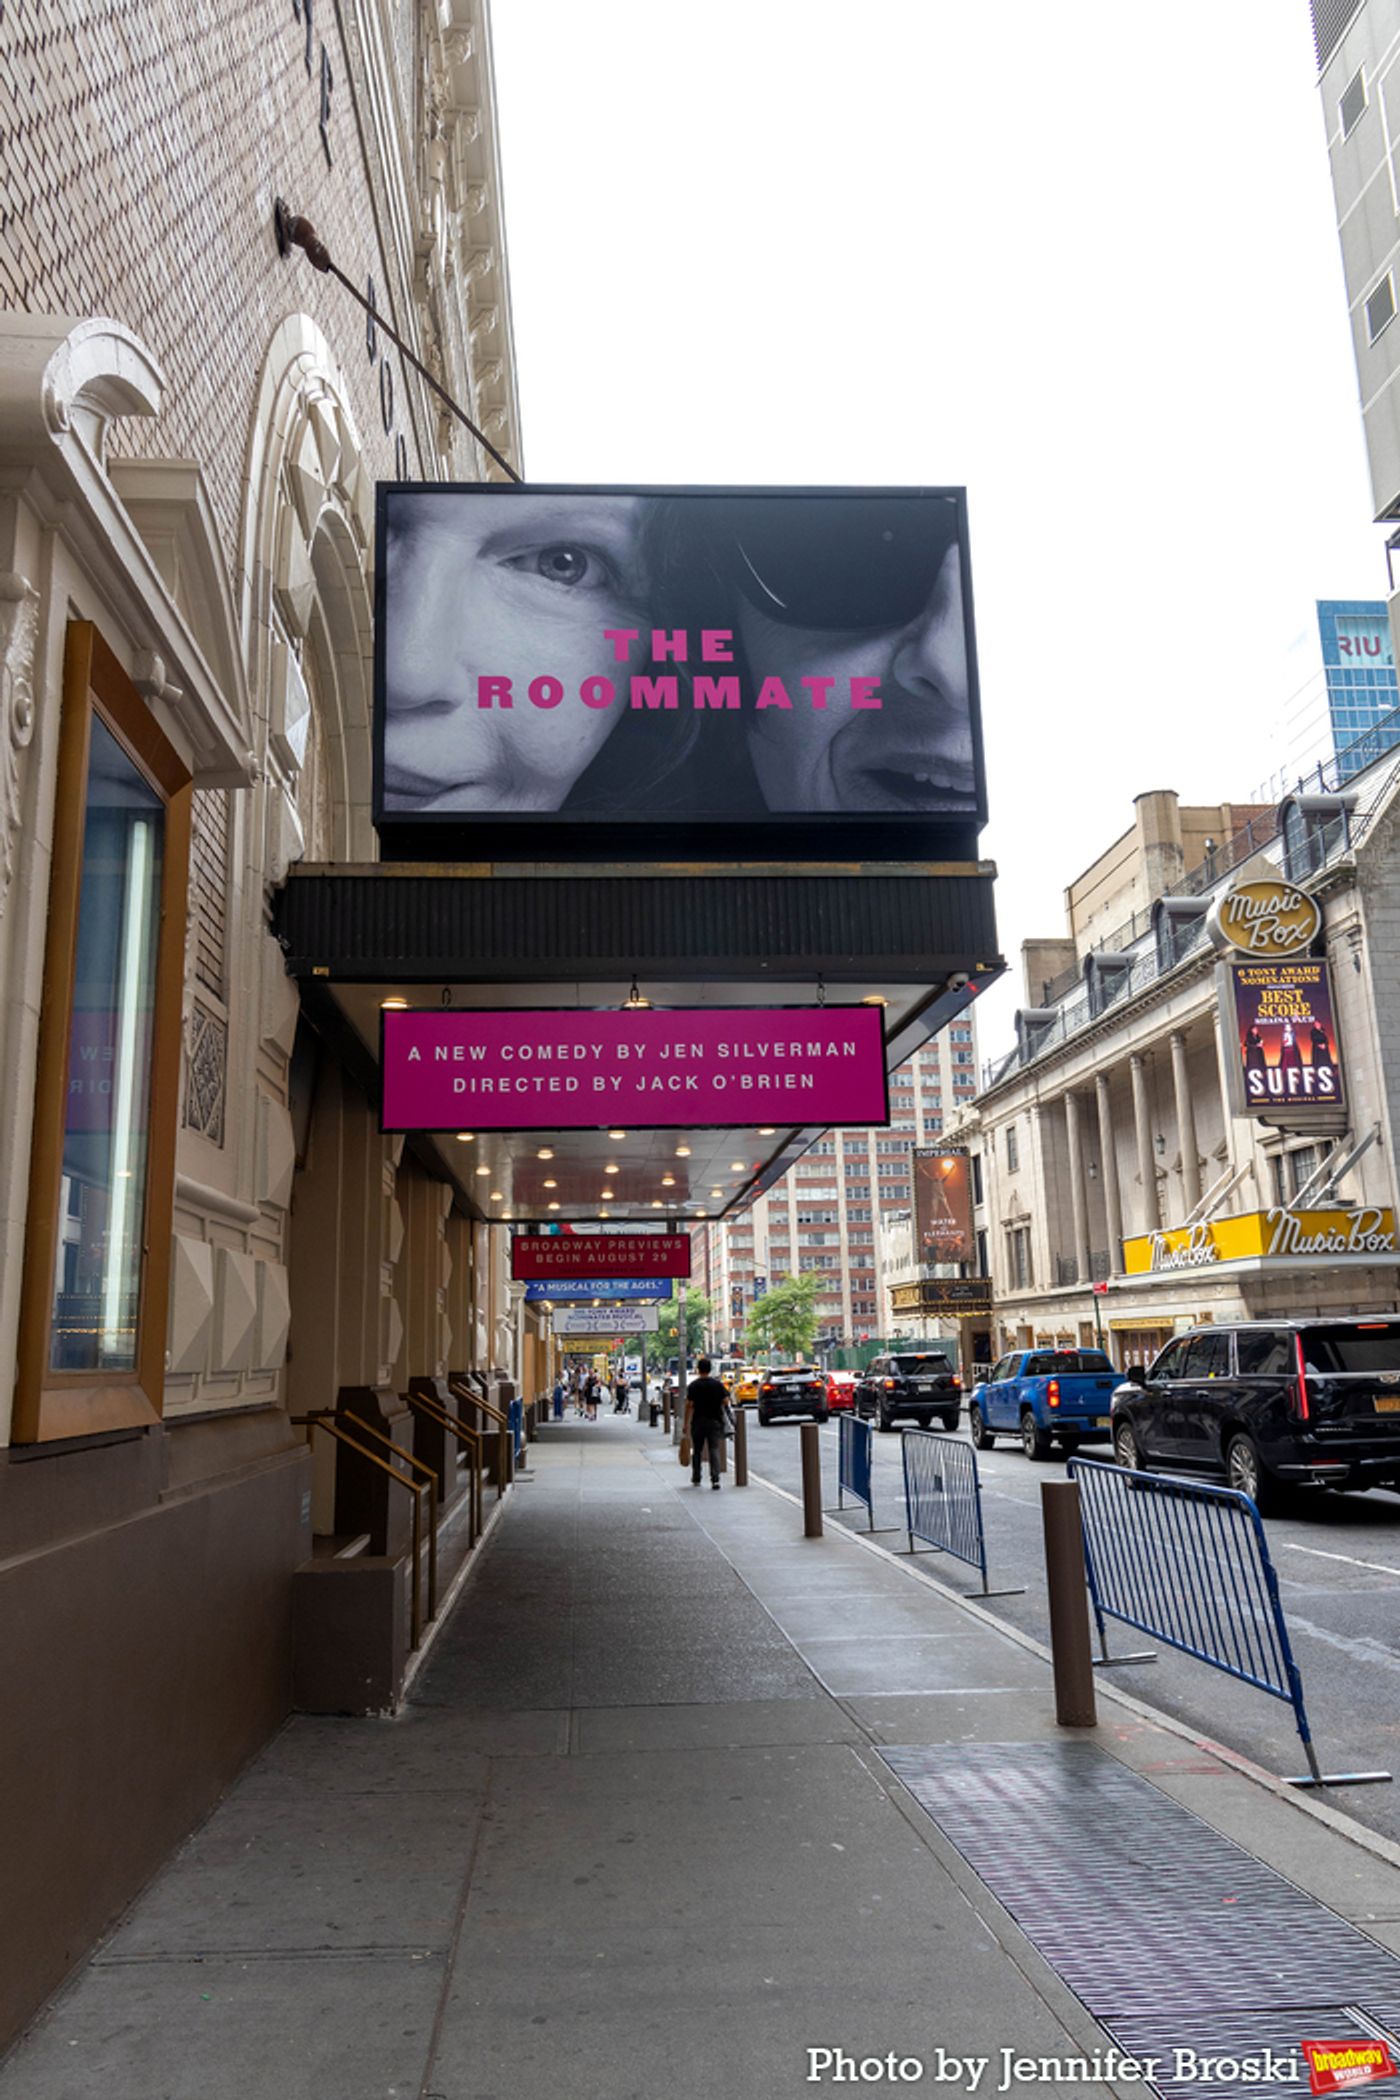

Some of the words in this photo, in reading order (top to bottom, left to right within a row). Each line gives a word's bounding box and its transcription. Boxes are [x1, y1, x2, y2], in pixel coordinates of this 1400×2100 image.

[604, 629, 734, 662] THE
[1338, 636, 1381, 656] RIU
[477, 675, 883, 709] ROOMMATE
[1225, 888, 1302, 923] Music
[1244, 915, 1311, 948] Box
[1241, 975, 1320, 985] NOMINATIONS
[1247, 968, 1277, 977] TONY
[1281, 966, 1321, 976] AWARD
[1261, 989, 1304, 1004] BEST
[1257, 1002, 1312, 1018] SCORE
[407, 1046, 421, 1061] A
[435, 1046, 487, 1061] NEW
[501, 1044, 603, 1060] COMEDY
[617, 1044, 646, 1060] BY
[659, 1043, 704, 1059] JEN
[717, 1041, 856, 1058] SILVERMAN
[453, 1076, 579, 1093] DIRECTED
[593, 1076, 622, 1092] BY
[635, 1075, 699, 1091] JACK
[712, 1073, 814, 1090] O'BRIEN
[1248, 1066, 1335, 1096] SUFFS
[1266, 1206, 1345, 1255] Music
[1345, 1207, 1395, 1251] Box
[520, 1239, 602, 1251] BROADWAY
[608, 1239, 683, 1250] PREVIEWS
[1148, 1229, 1190, 1271] Music
[1187, 1220, 1216, 1265] Box
[536, 1253, 581, 1264] BEGIN
[588, 1252, 645, 1263] AUGUST
[652, 1251, 668, 1262] 29
[546, 1281, 588, 1292] MUSICAL
[591, 1281, 609, 1290] FOR
[613, 1281, 629, 1289] THE
